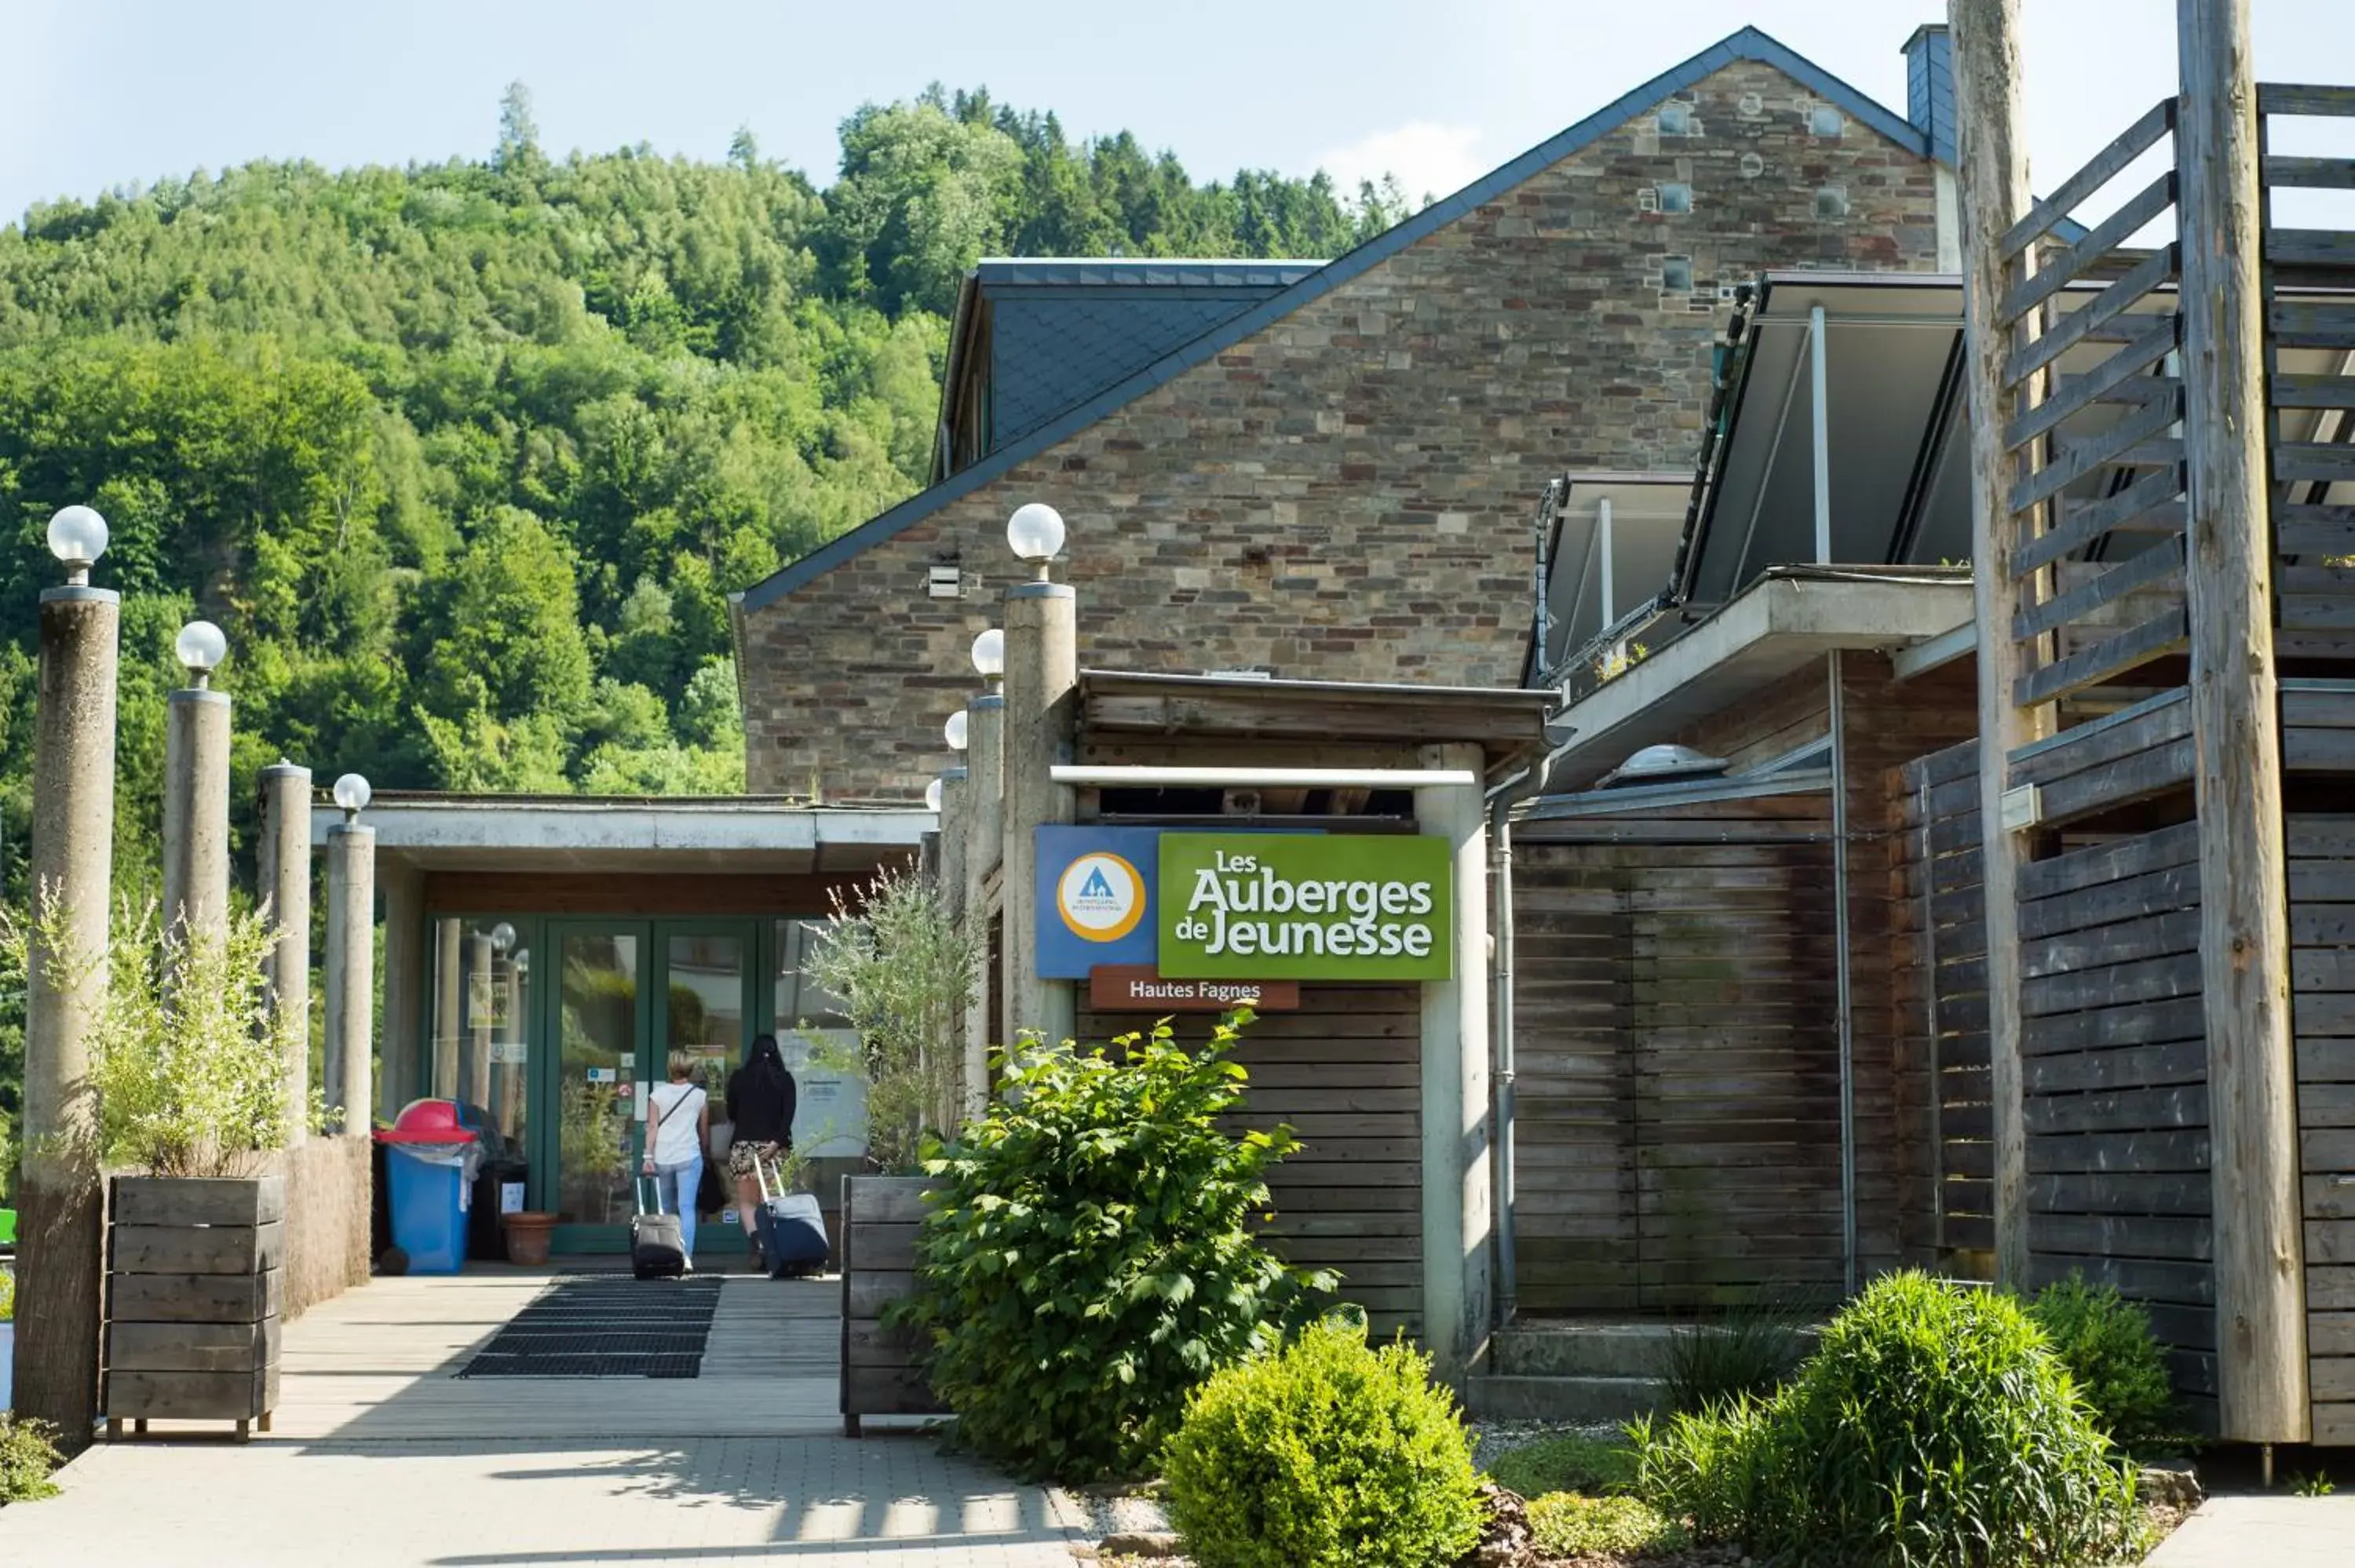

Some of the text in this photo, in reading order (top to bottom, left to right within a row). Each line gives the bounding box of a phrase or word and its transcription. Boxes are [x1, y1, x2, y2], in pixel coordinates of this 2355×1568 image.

[1215, 851, 1258, 873] Les
[1188, 866, 1433, 926] Auberges
[1176, 909, 1433, 957] de Jeunesse
[1130, 981, 1261, 1001] Hautes Fagnes
